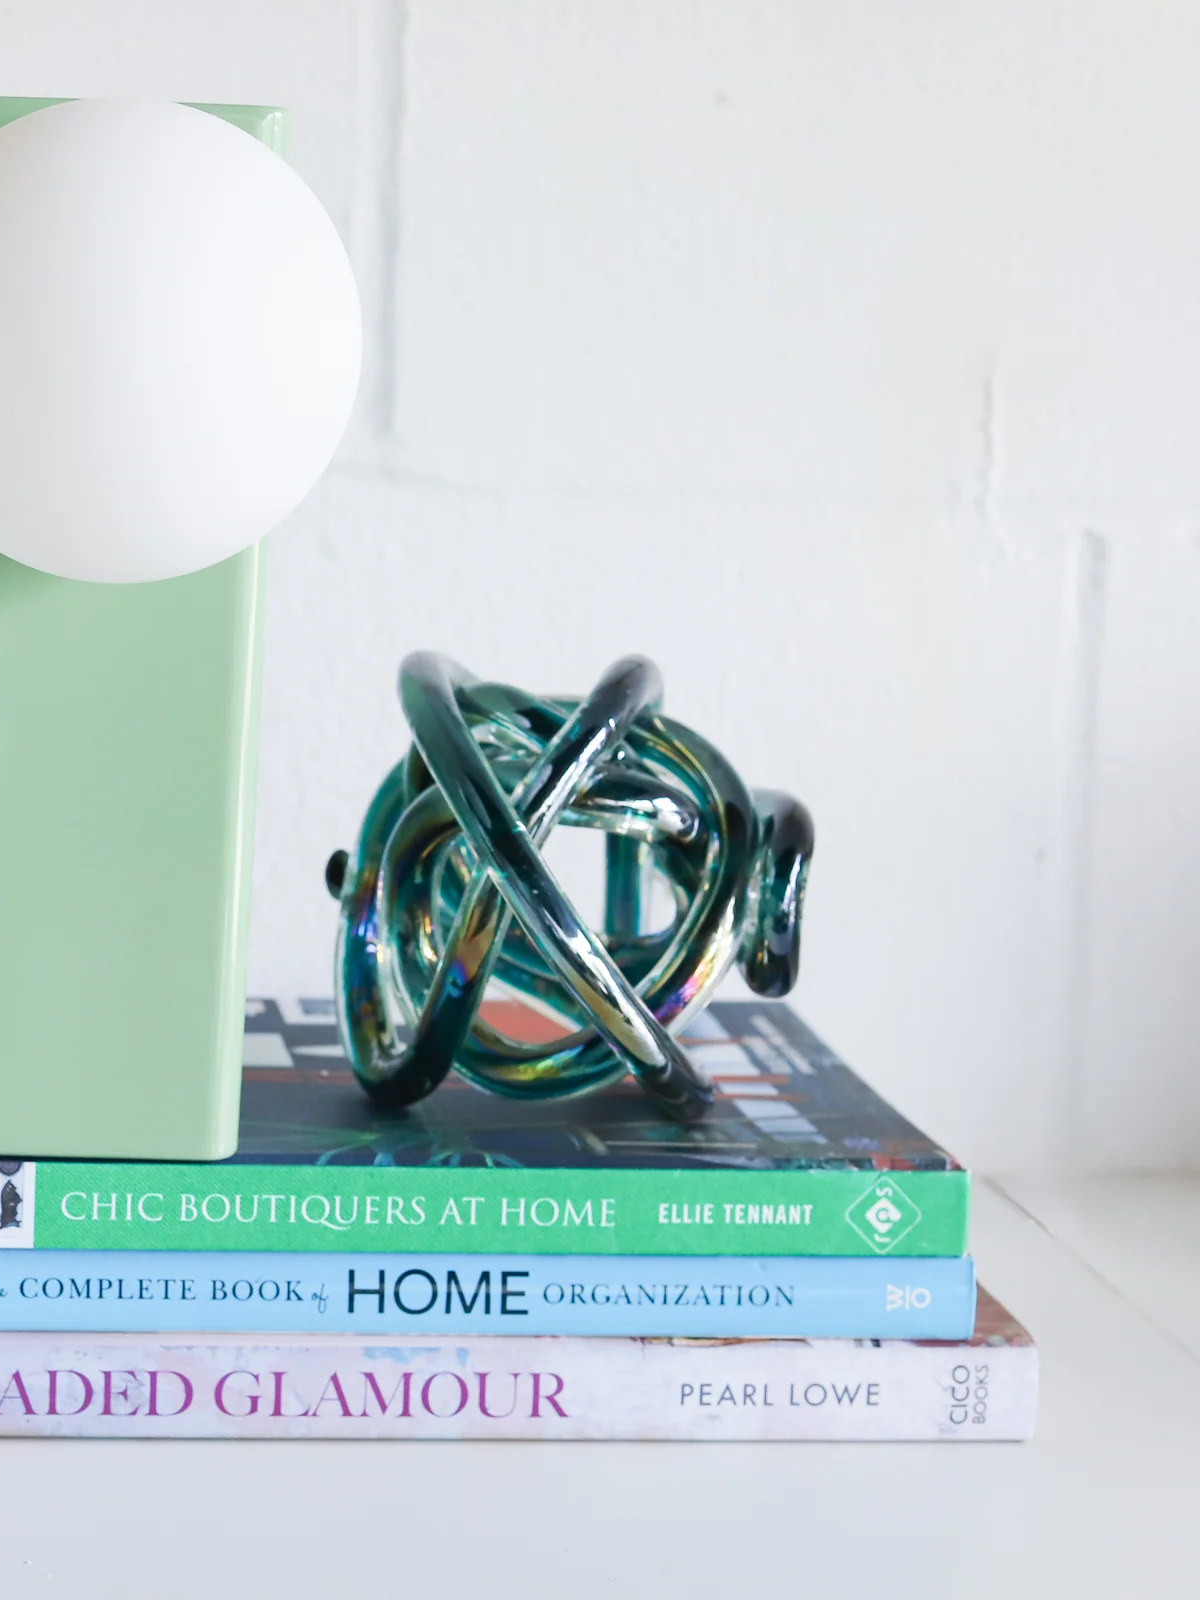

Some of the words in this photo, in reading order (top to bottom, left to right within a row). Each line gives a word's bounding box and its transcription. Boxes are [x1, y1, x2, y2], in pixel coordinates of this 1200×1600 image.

[60, 1191, 164, 1223] CHIC
[178, 1192, 427, 1231] BOUTIQUERS
[440, 1196, 486, 1227] AT
[499, 1196, 617, 1228] HOME
[657, 1203, 715, 1226] ELLIE
[723, 1203, 814, 1227] TENNANT
[19, 1276, 197, 1302] COMPLETE
[210, 1277, 304, 1303] BOOK
[310, 1285, 330, 1315] of
[347, 1268, 531, 1315] HOME
[542, 1282, 796, 1308] ORGANIZATION
[213, 1369, 571, 1419] GLAMOUR
[679, 1382, 774, 1408] PEARL
[789, 1382, 882, 1408] LOWE
[949, 1365, 970, 1424] CICO
[972, 1364, 989, 1424] BOOKS
